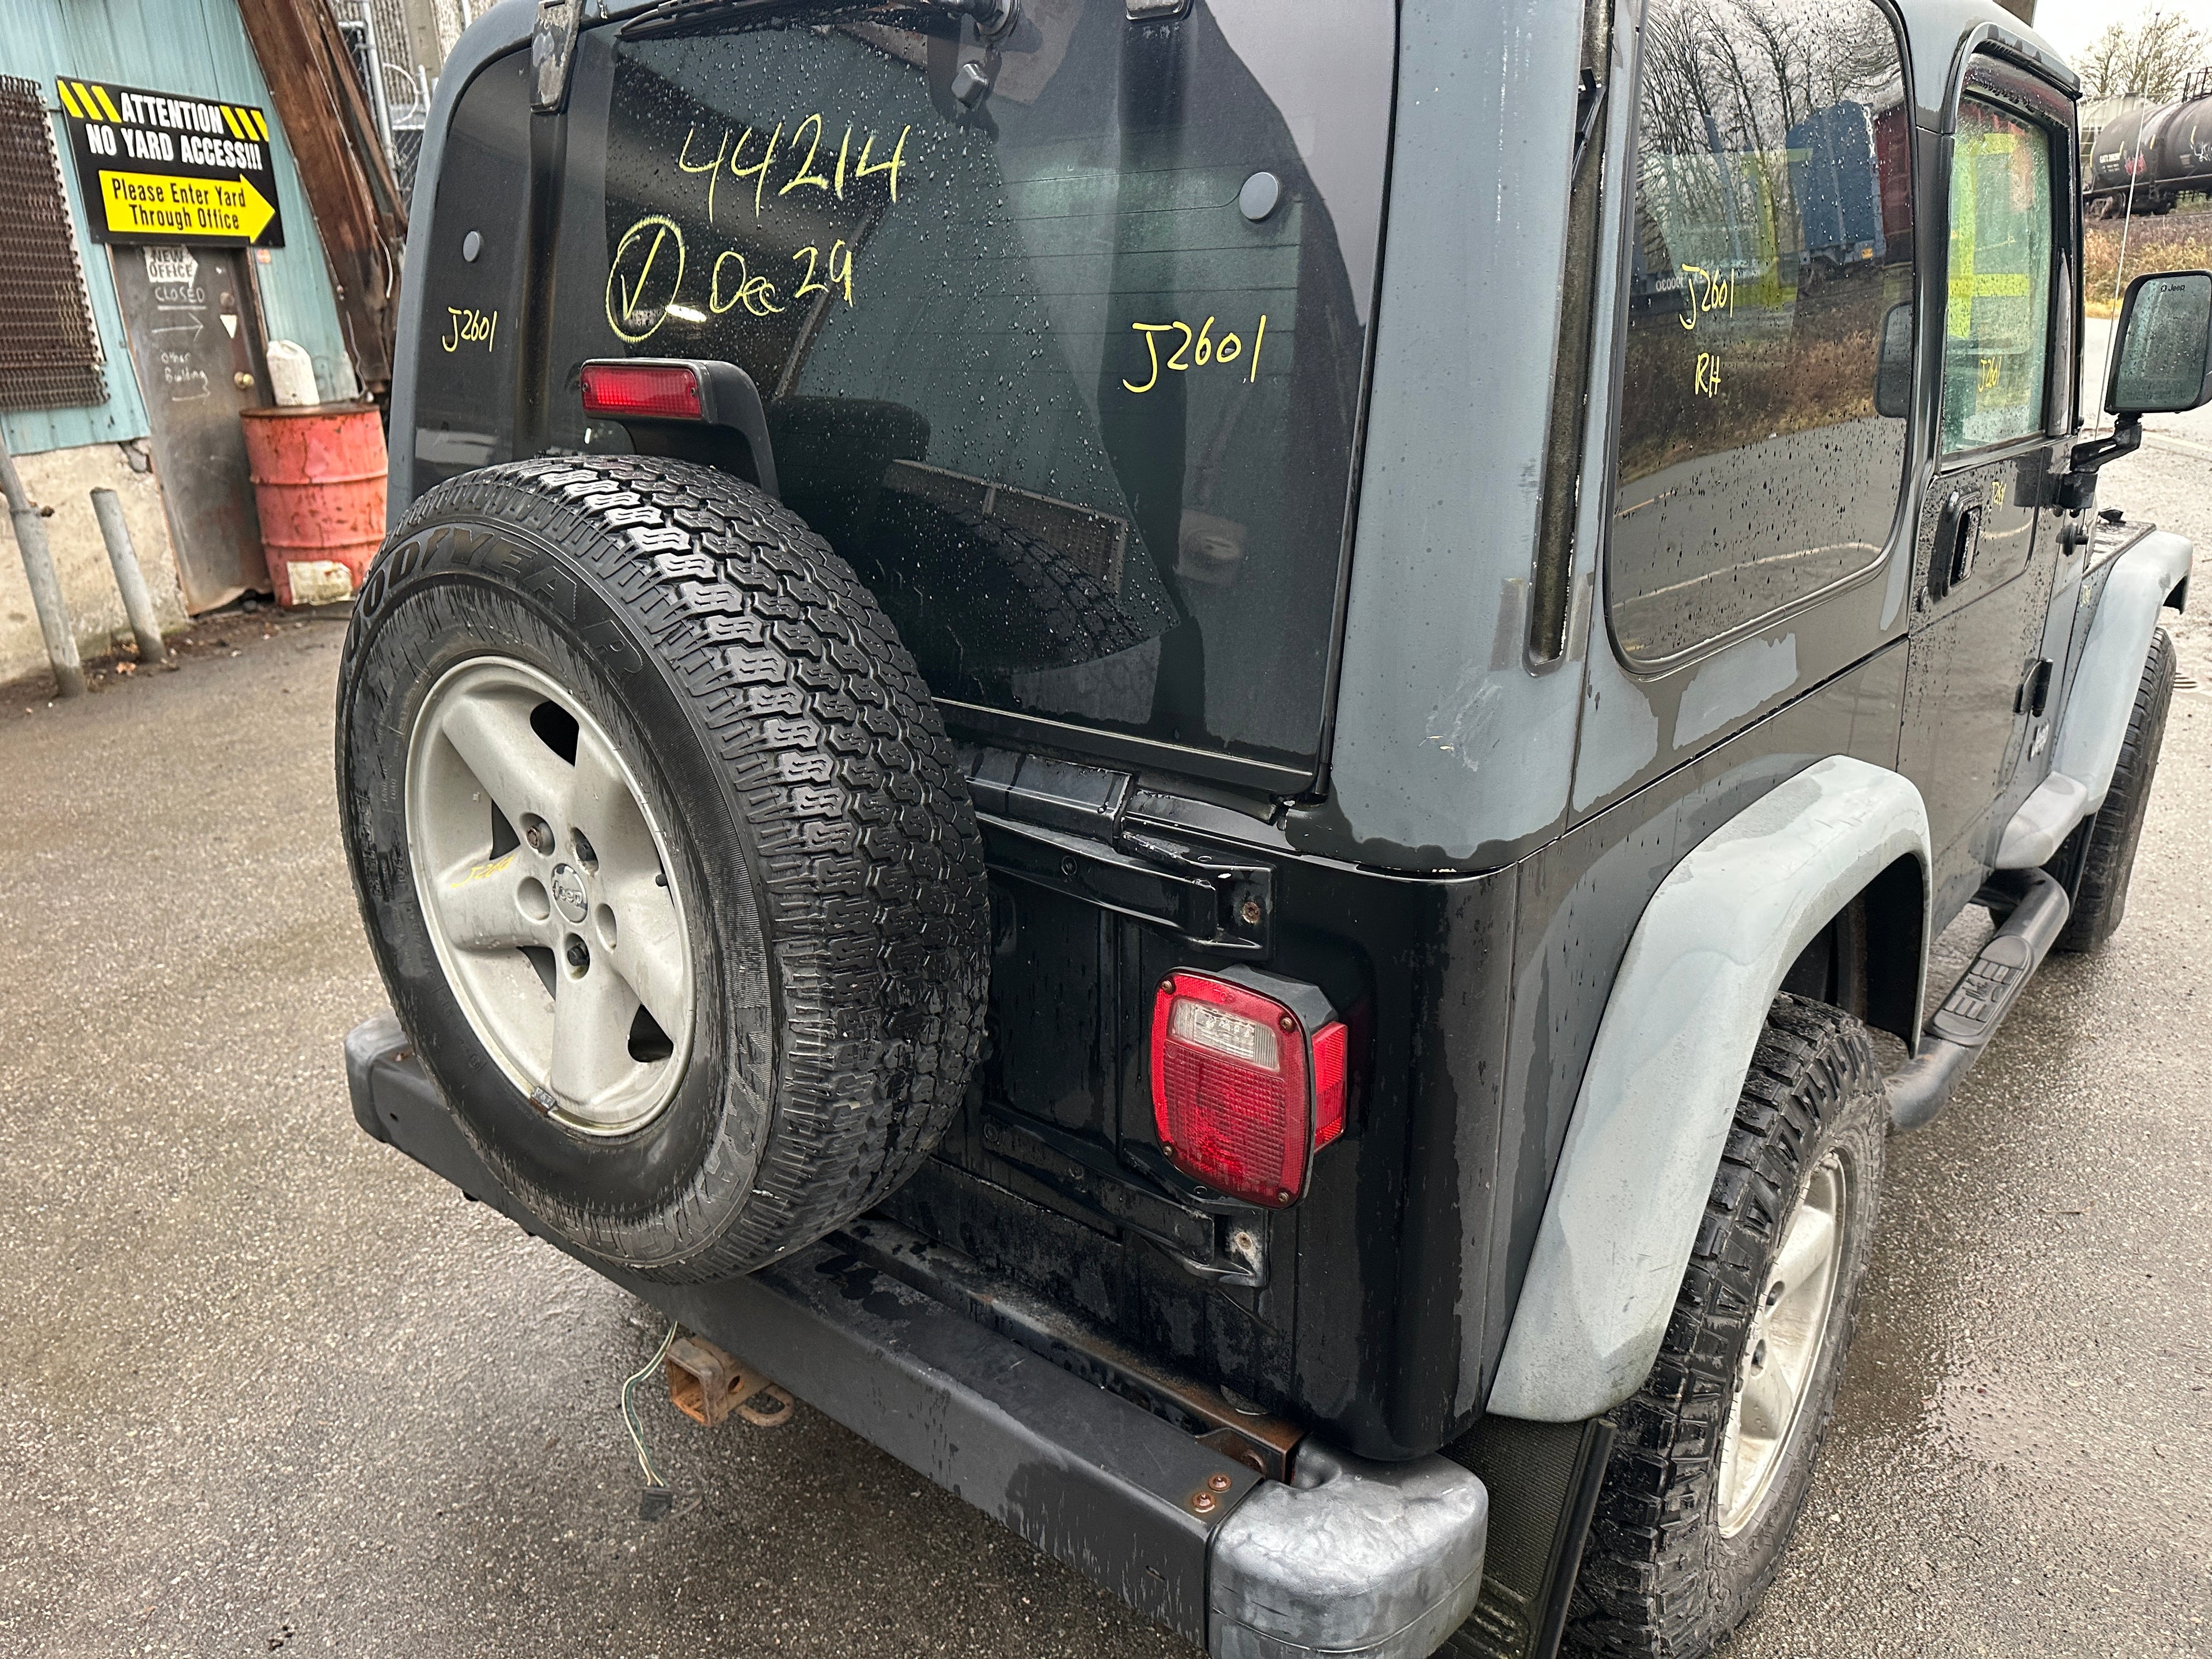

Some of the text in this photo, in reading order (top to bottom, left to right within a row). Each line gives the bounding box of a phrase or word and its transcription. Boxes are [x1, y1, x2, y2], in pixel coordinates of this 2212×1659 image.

[121, 92, 224, 134] ATTENTION
[86, 124, 263, 171] NO YARD ACCESS!!!
[678, 113, 911, 221] 44214
[112, 178, 246, 207] Please Enter Yard
[129, 204, 239, 230] Through Office
[149, 262, 192, 278] OFFICE
[151, 248, 184, 263] NEW
[793, 239, 854, 308] 29
[155, 286, 205, 303] CLOSED
[1679, 263, 1734, 330] J2601
[442, 306, 498, 353] J2601
[1122, 315, 1267, 393] J2601
[1695, 352, 1721, 398] RH
[1978, 356, 2002, 393] J2601
[552, 880, 583, 907] Jeep
